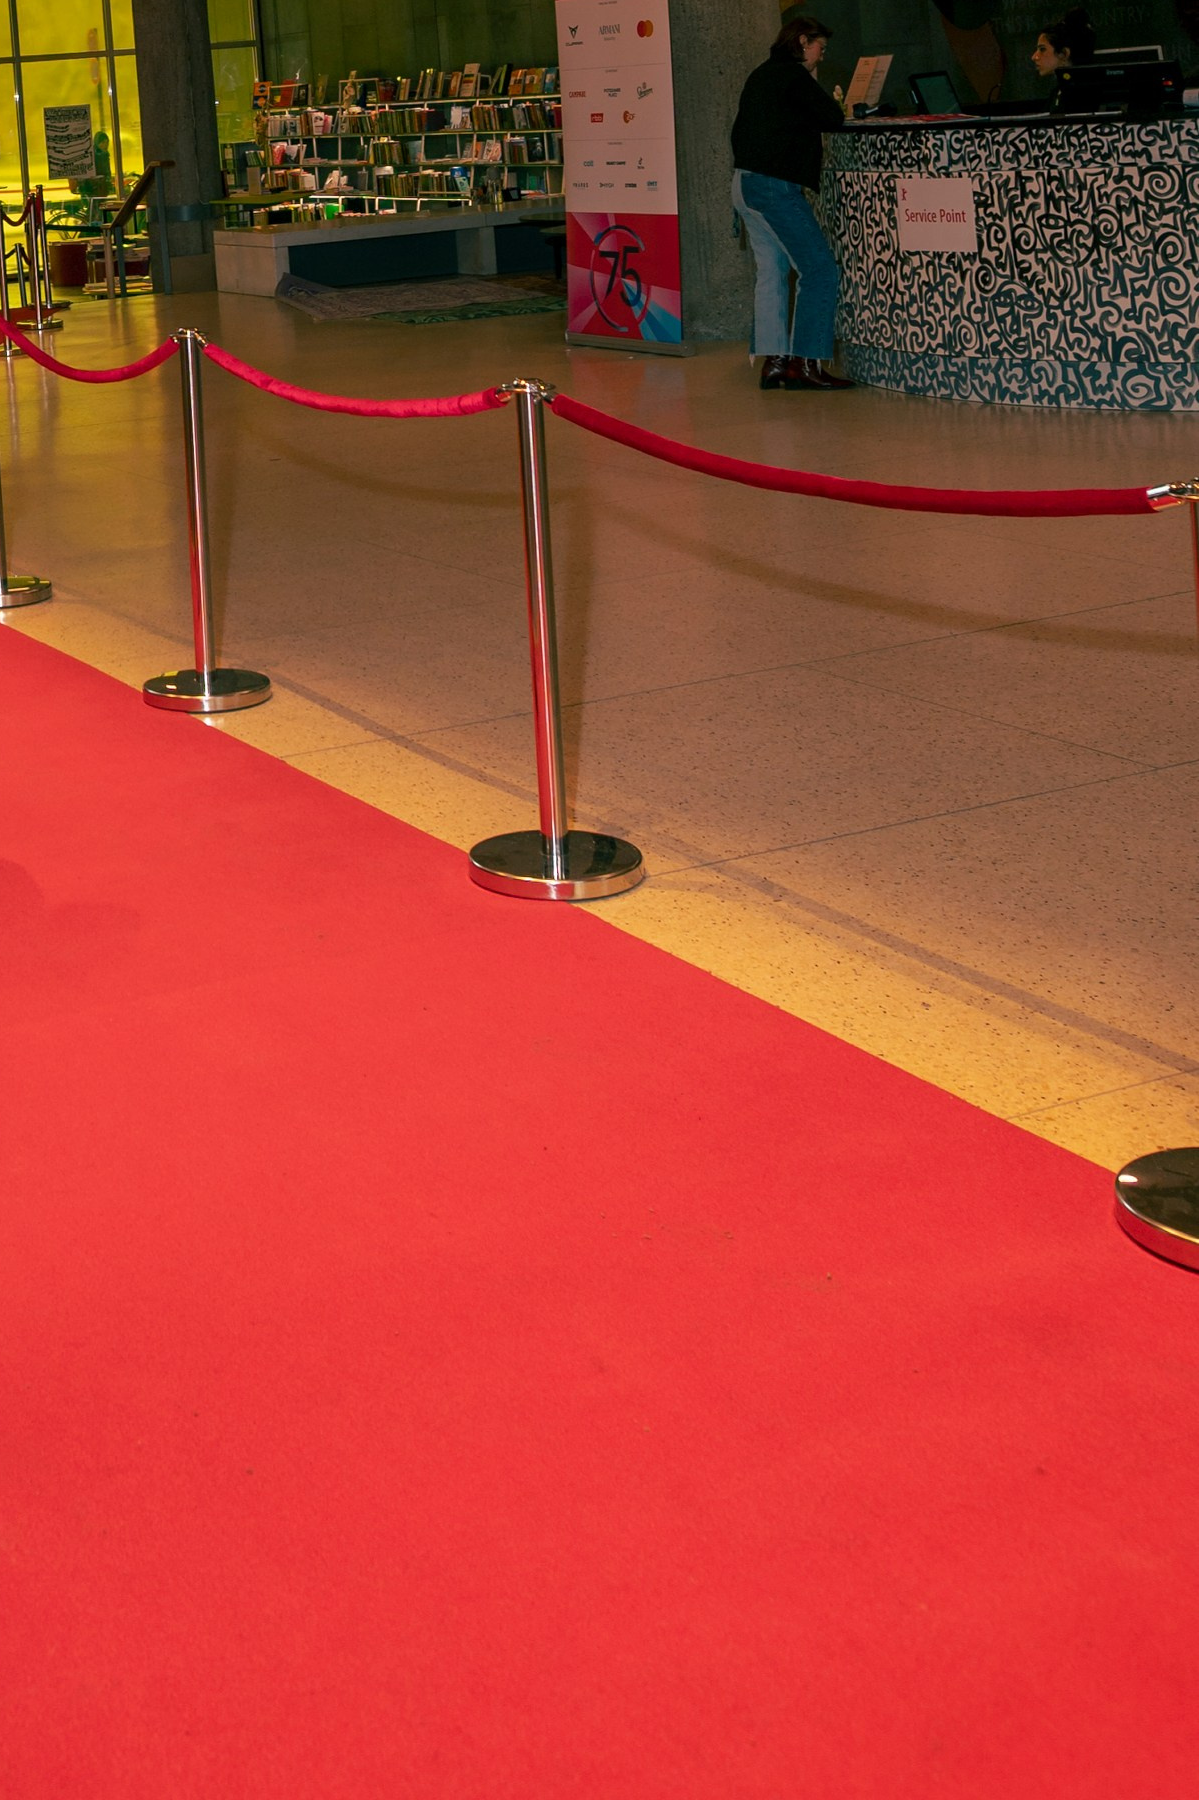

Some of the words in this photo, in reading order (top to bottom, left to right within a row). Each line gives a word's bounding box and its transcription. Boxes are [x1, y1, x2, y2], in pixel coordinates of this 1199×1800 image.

[599, 23, 621, 35] ARMANI
[905, 208, 937, 223] Service
[939, 209, 967, 223] Point
[598, 245, 642, 307] 75
